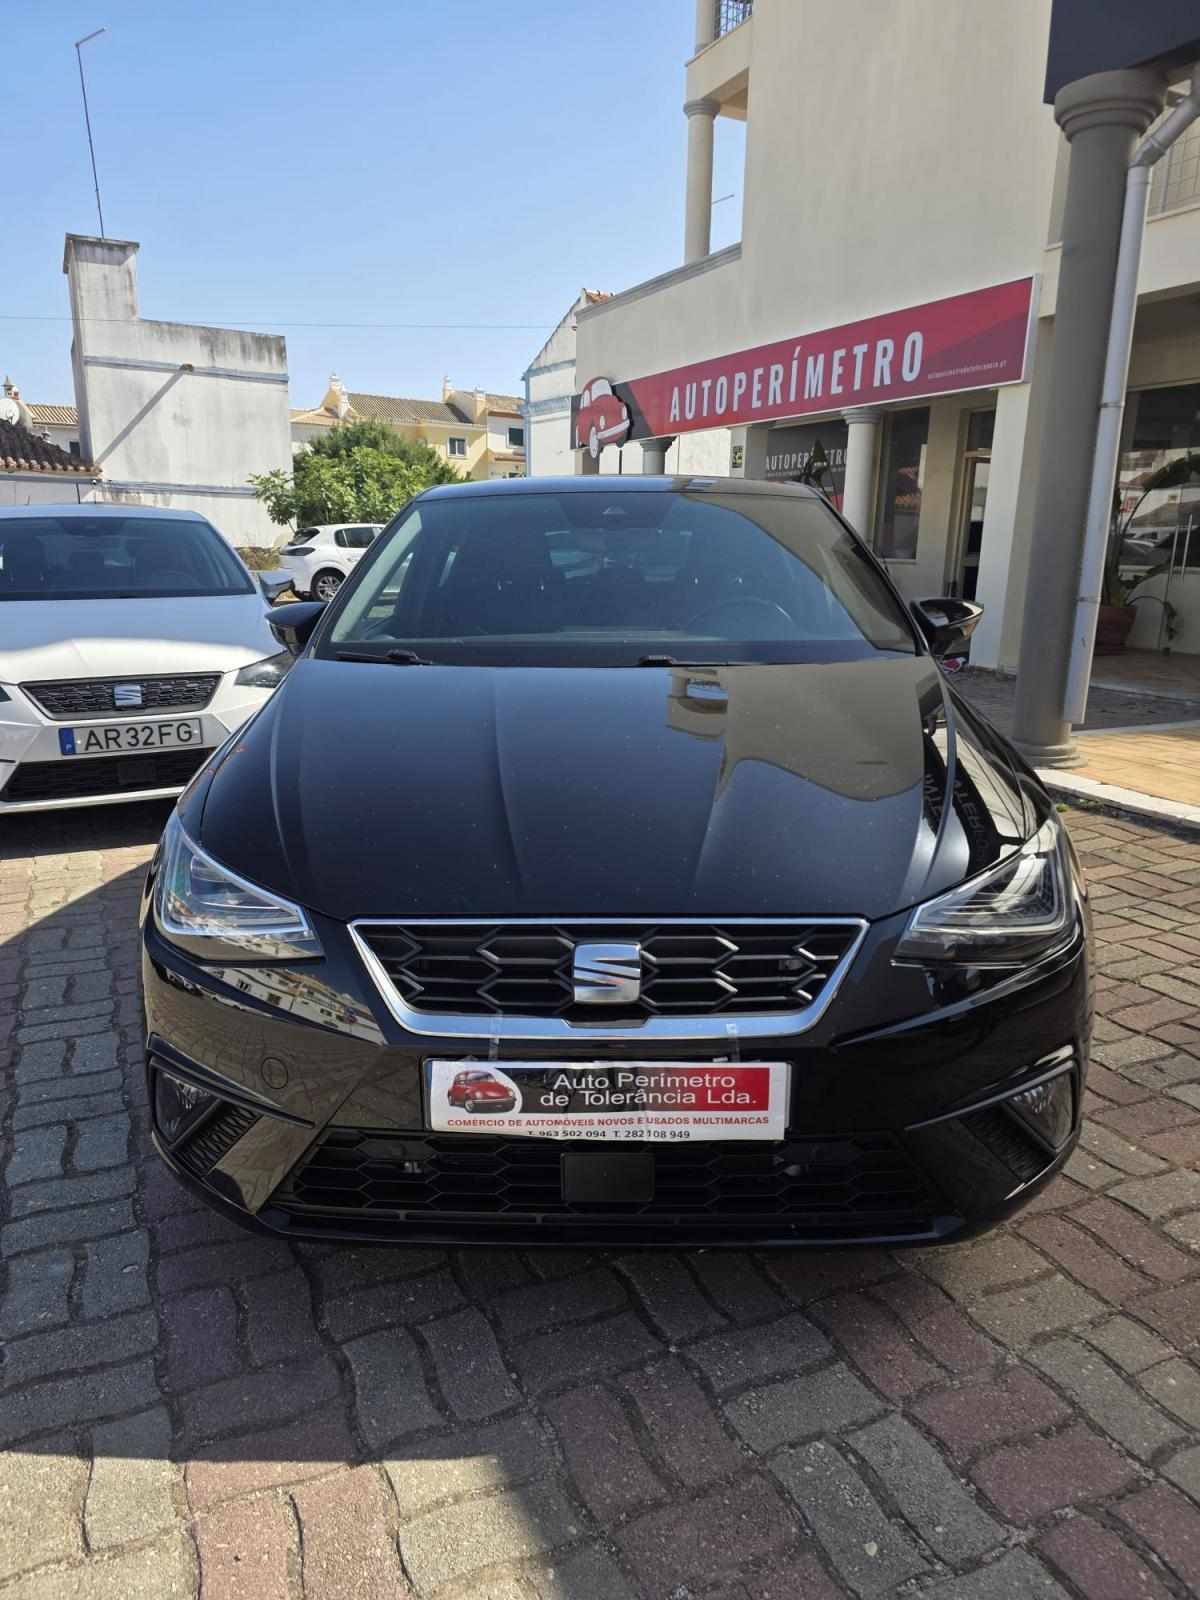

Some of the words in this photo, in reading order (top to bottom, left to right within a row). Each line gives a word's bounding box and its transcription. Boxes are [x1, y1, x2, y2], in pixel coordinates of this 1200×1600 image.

[669, 330, 925, 423] AUTOPERÍMETRO
[84, 722, 193, 751] AR32FG
[553, 1073, 609, 1090] Auto
[618, 1072, 736, 1088] Perímetro
[540, 1091, 569, 1106] de
[579, 1089, 696, 1105] Tolerância
[707, 1090, 757, 1104] Lda.
[508, 1118, 523, 1127] DE
[598, 1117, 634, 1126] NOVOS
[637, 1117, 643, 1125] E
[647, 1117, 690, 1125] USADOS
[693, 1116, 769, 1125] MULTIMARCAS
[585, 1130, 606, 1138] 094
[624, 1130, 645, 1138] 282
[647, 1129, 667, 1138] 108
[670, 1130, 690, 1139] 949
